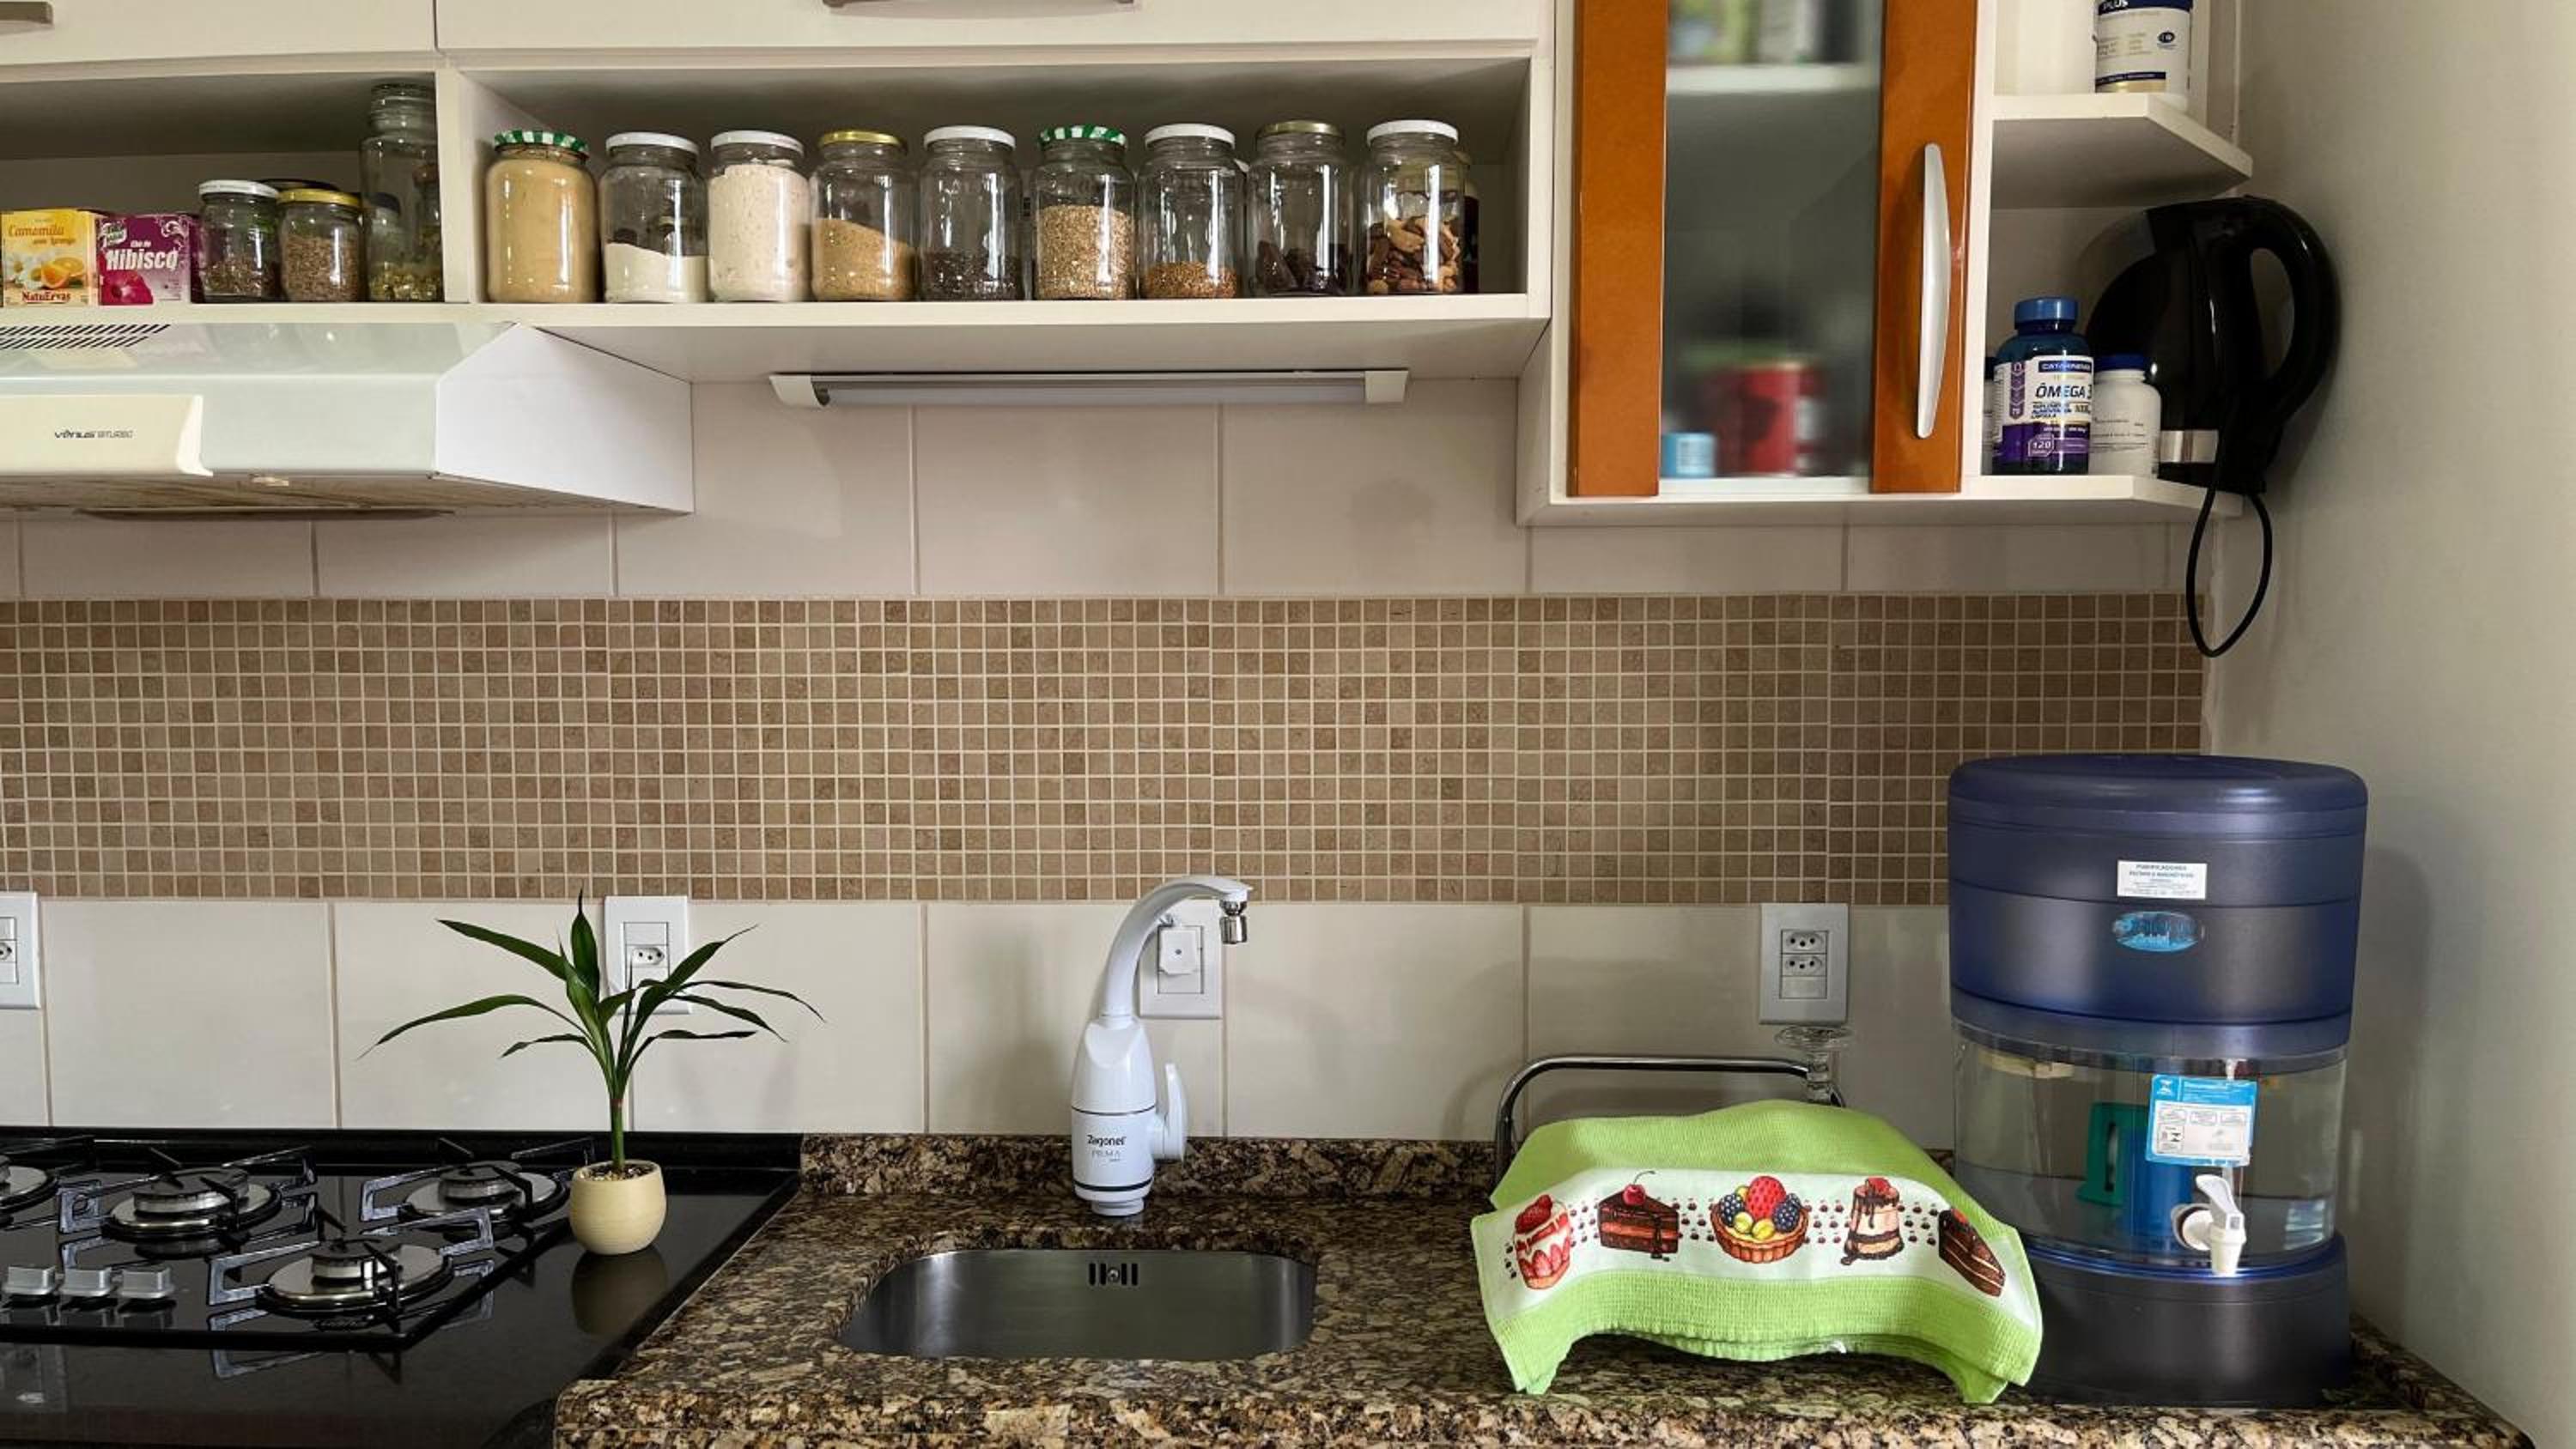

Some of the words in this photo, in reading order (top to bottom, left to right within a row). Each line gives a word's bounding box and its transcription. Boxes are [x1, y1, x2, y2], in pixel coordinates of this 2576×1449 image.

[9, 224, 64, 237] Camomila
[106, 248, 179, 271] Hibisco
[2036, 383, 2085, 398] ÔMEGA
